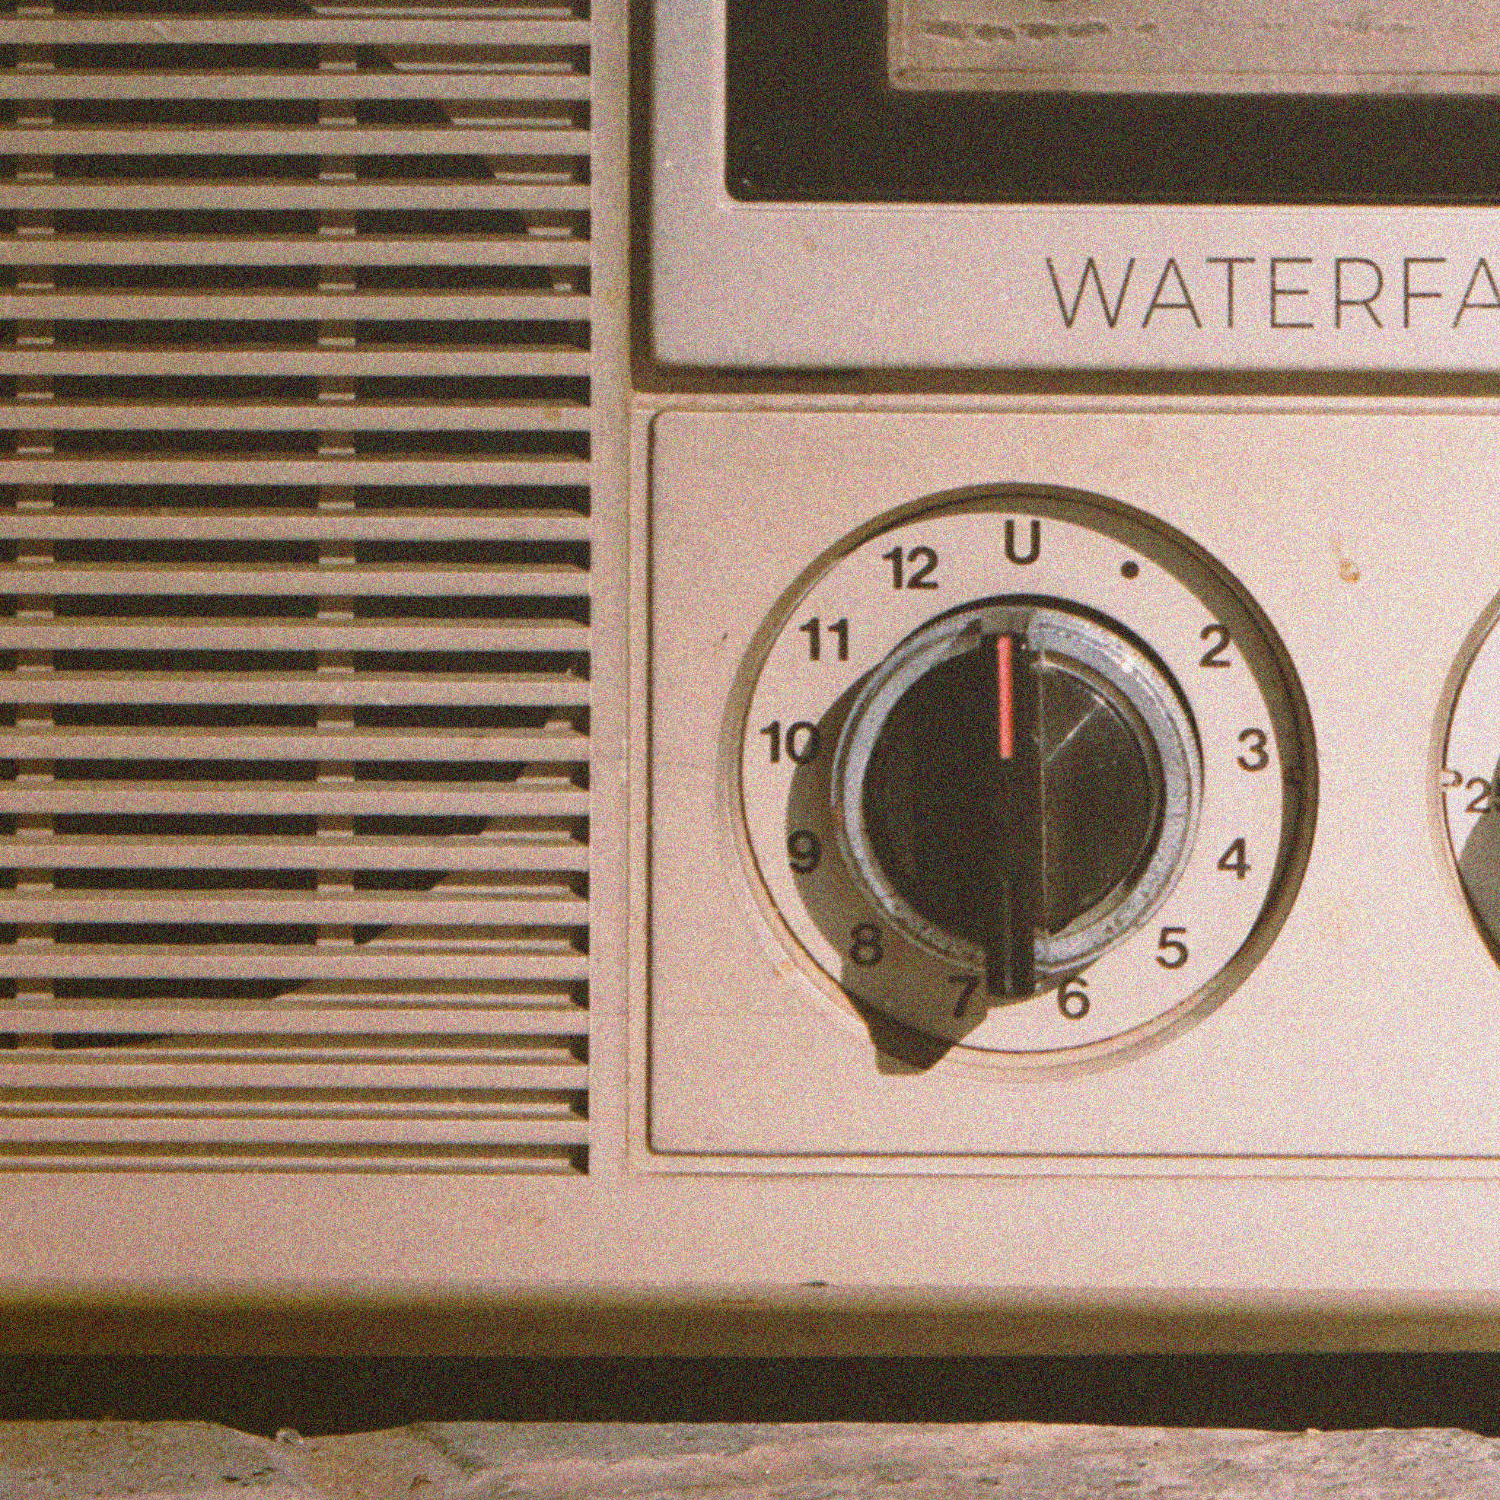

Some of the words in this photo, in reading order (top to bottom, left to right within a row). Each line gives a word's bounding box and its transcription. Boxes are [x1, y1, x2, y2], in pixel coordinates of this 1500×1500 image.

[1003, 520, 1042, 566] U
[882, 545, 940, 590] 12
[798, 617, 851, 662] 11
[1199, 622, 1232, 669] 2
[759, 720, 819, 764] 10
[1235, 727, 1269, 773] 3
[786, 829, 822, 875] 9
[1216, 837, 1252, 880] 4
[848, 921, 884, 968] 8
[1155, 925, 1191, 971] 5
[947, 974, 981, 1019] 7
[1056, 977, 1092, 1021] 6
